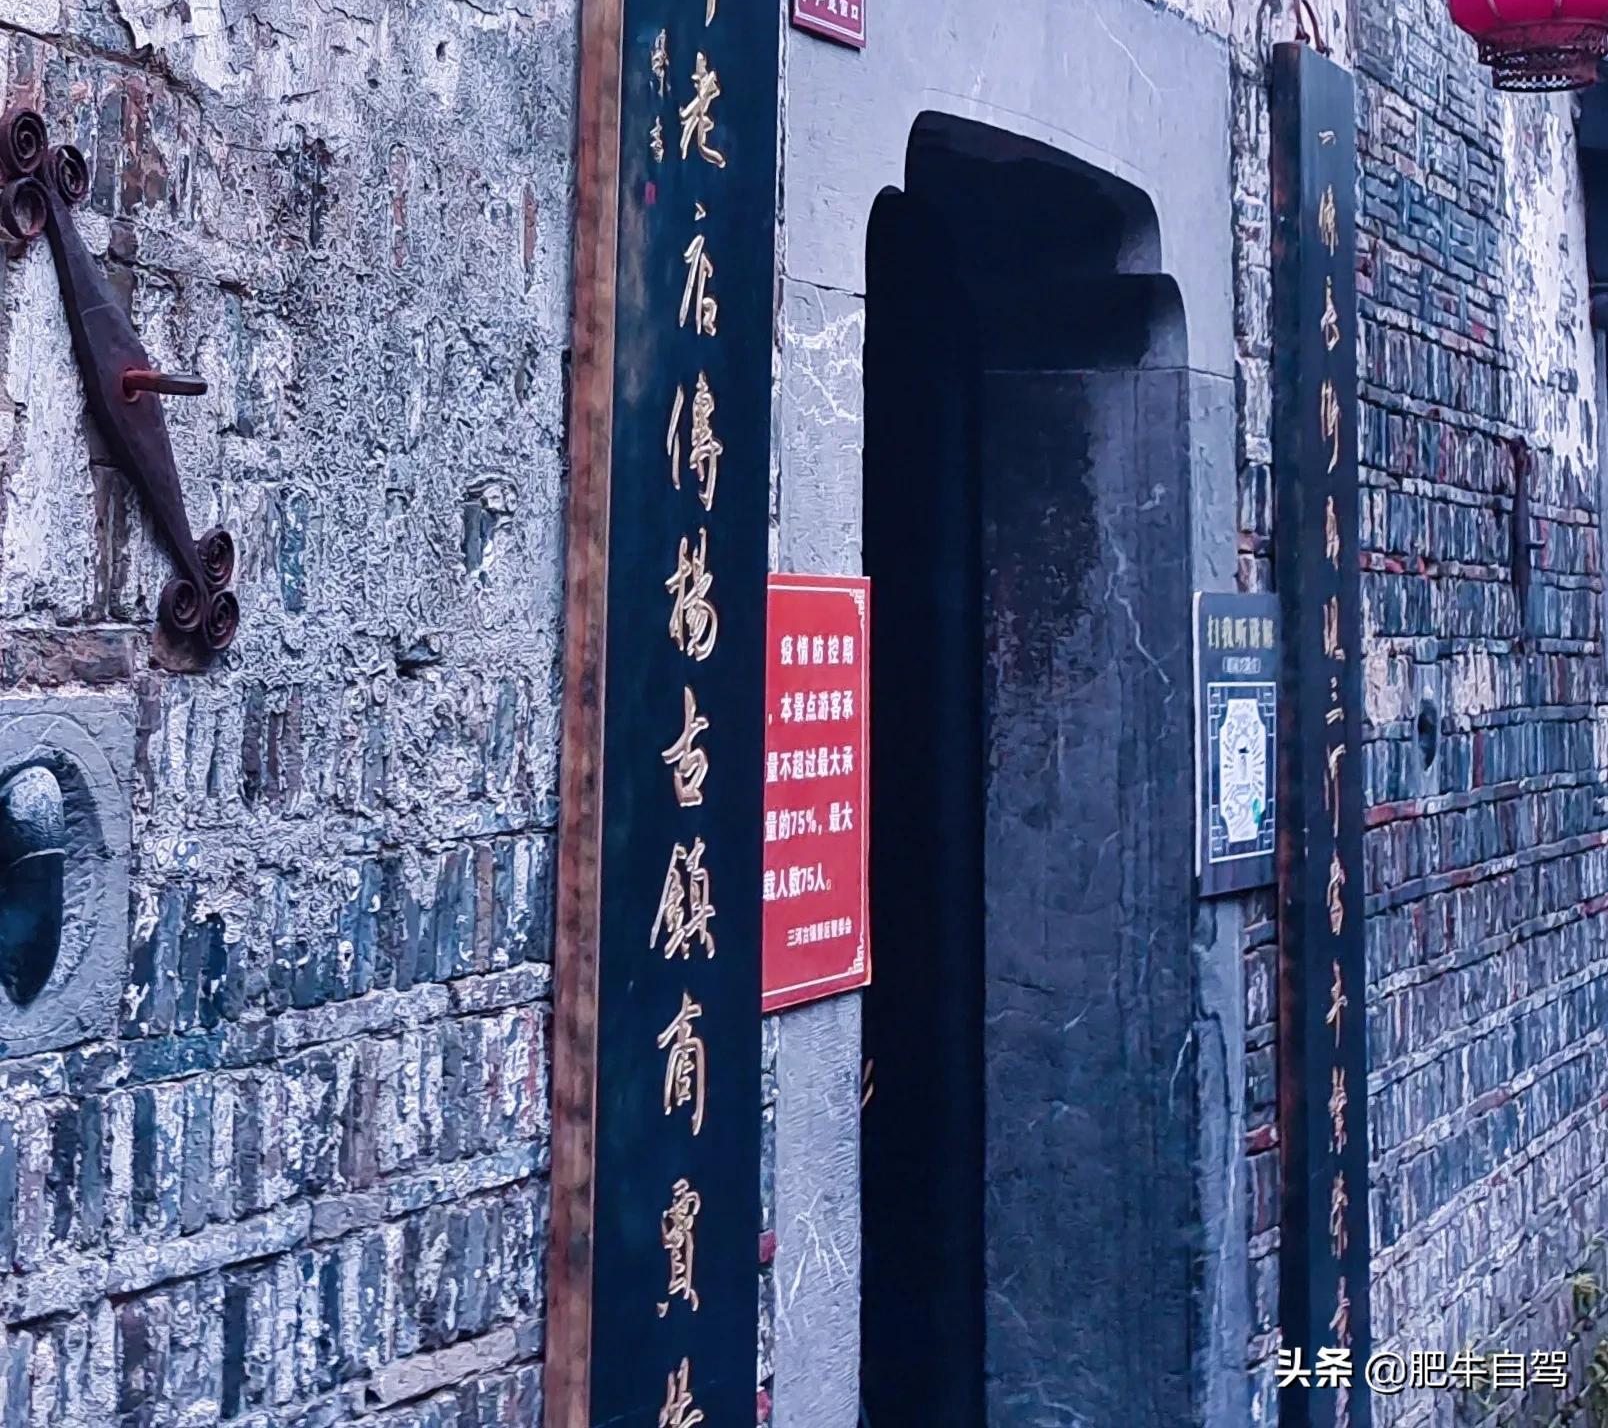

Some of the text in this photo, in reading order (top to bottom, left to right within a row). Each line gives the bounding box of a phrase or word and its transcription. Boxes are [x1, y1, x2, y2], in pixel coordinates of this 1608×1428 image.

[780, 635, 854, 666] 疫情防控期
[766, 745, 854, 784] 量不超过最大承
